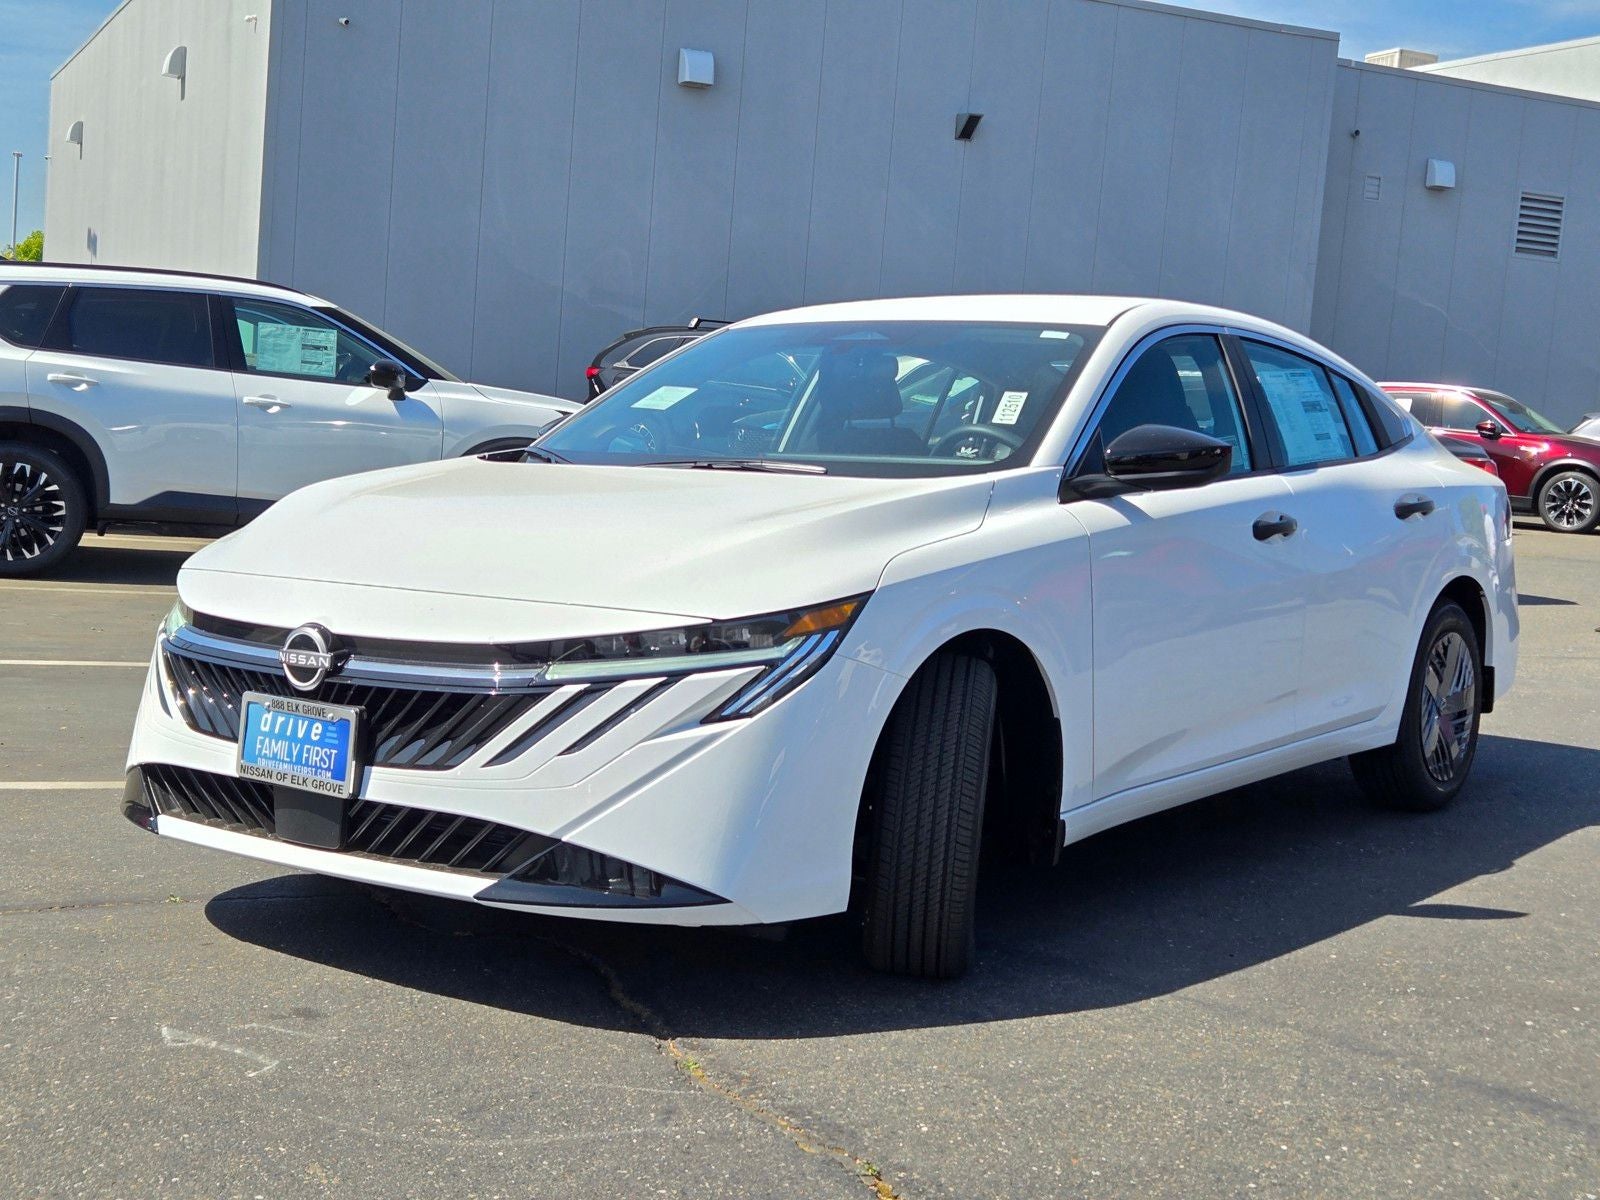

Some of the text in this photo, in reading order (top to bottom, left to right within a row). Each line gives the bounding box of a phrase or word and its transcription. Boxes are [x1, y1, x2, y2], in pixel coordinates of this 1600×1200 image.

[279, 650, 330, 667] NISSAN
[287, 701, 300, 713] ELK
[302, 704, 327, 718] GROVE
[261, 711, 323, 741] drive
[255, 736, 338, 770] FAMILY FIRST
[240, 764, 344, 795] NISSAN OF ELK GROVE
